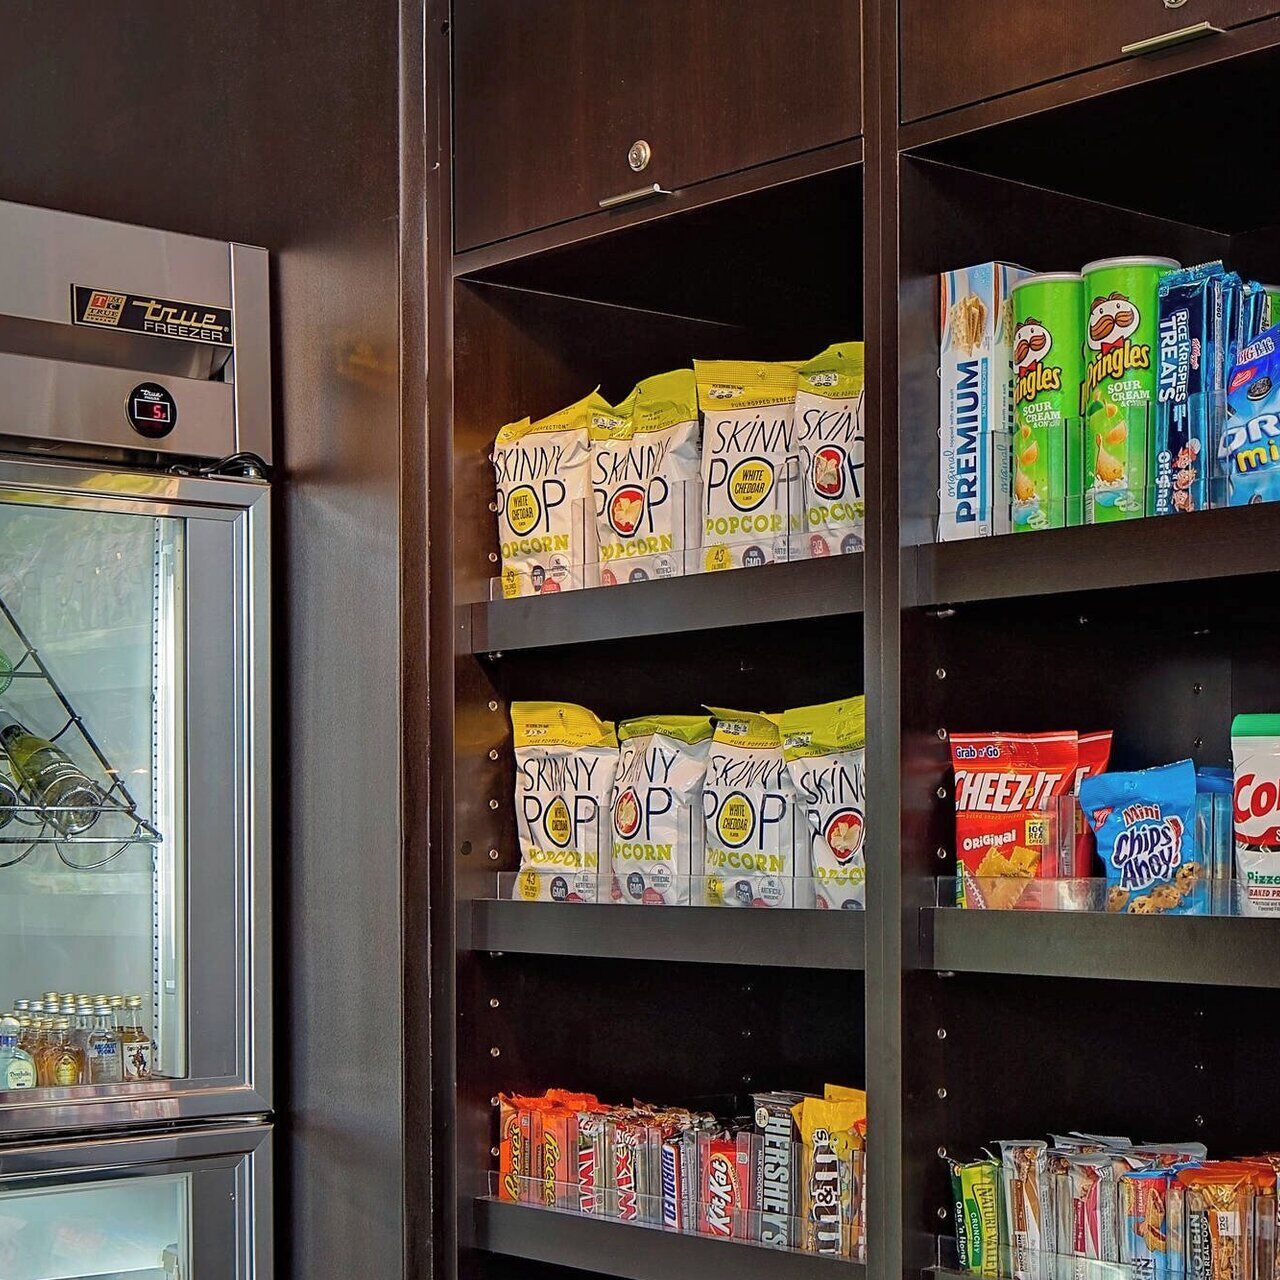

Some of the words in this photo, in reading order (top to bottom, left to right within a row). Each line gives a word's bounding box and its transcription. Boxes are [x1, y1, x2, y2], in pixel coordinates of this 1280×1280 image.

[144, 321, 223, 341] FREEZER
[1175, 311, 1188, 340] RICE
[1158, 316, 1177, 403] TREATS
[1174, 341, 1190, 403] KRISPIES
[1107, 380, 1142, 394] SOUR
[1111, 389, 1150, 401] CREAM
[1022, 402, 1052, 415] SOUR
[1025, 410, 1061, 423] CREAM
[955, 359, 979, 523] PREMIUM
[742, 468, 764, 481] WHITE
[734, 480, 765, 495] CHEDDAR
[955, 746, 978, 759] Grab
[985, 747, 1000, 759] Go
[729, 804, 746, 816] WHITE
[1122, 803, 1160, 827] Mini
[722, 815, 748, 831] CHEDDAR
[1114, 823, 1173, 868] Chips
[1248, 888, 1270, 898] BAKED
[762, 1116, 791, 1249] HERSHEY'S
